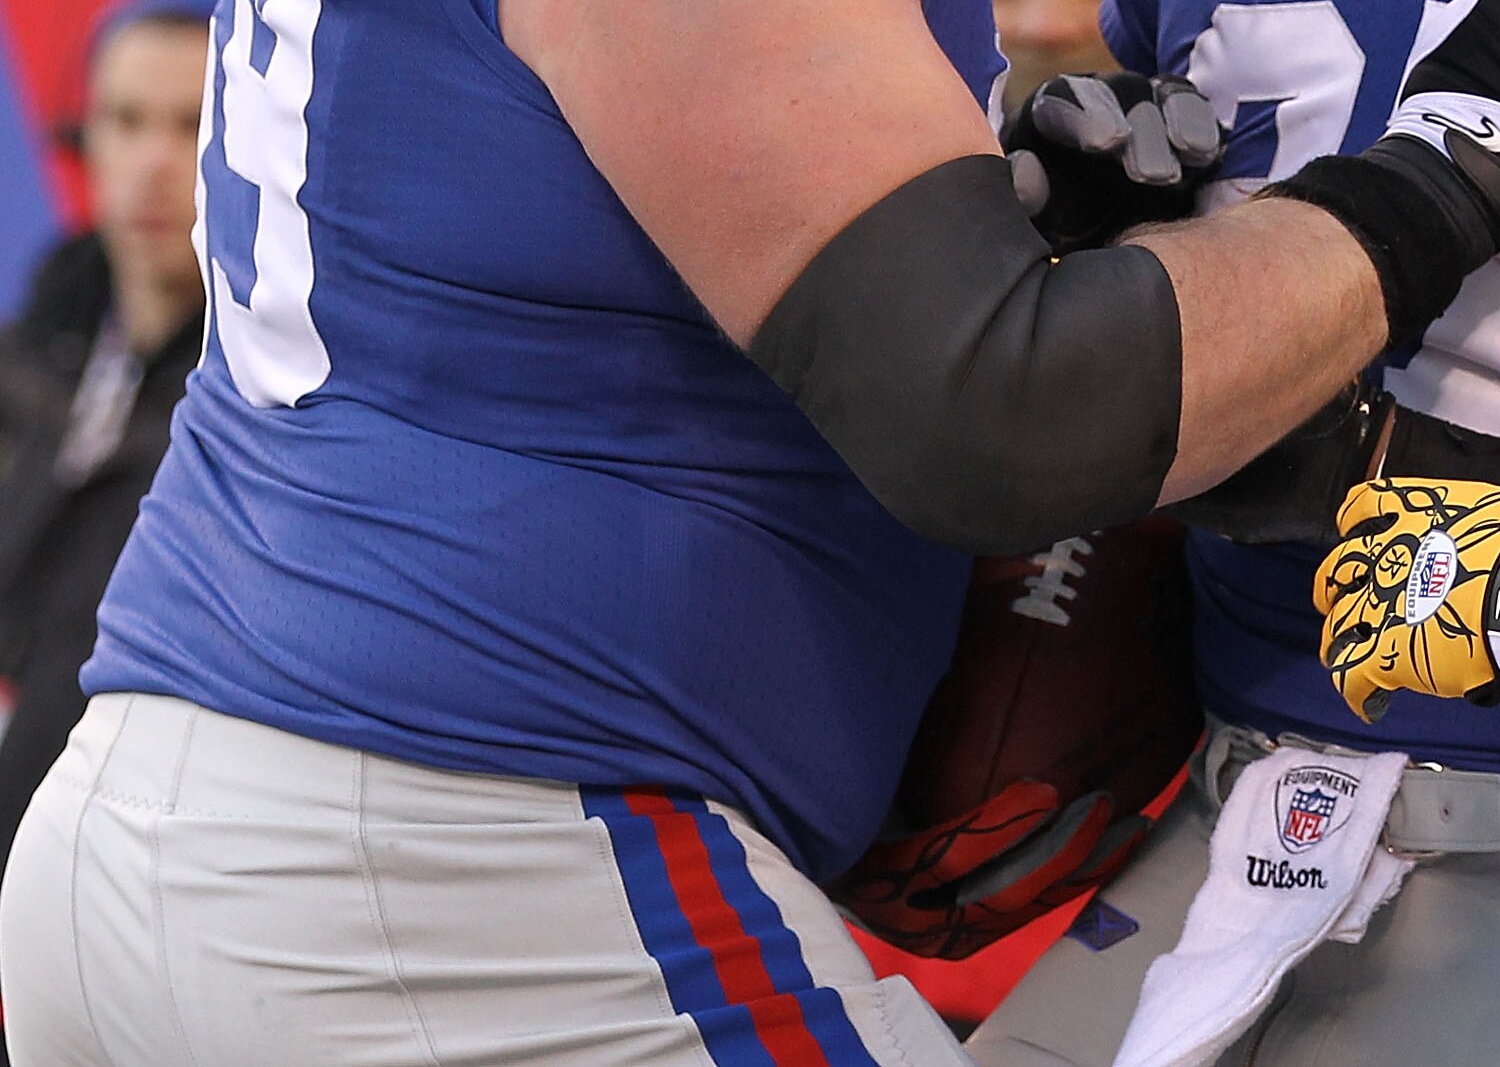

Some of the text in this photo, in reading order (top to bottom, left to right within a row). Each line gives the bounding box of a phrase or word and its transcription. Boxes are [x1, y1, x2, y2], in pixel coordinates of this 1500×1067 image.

[1407, 535, 1436, 619] EQUIPMENT
[1428, 555, 1450, 594] NFL
[1284, 770, 1360, 798] EQUIPMENT
[1284, 810, 1323, 841] NFL
[1246, 855, 1328, 889] Wilson
